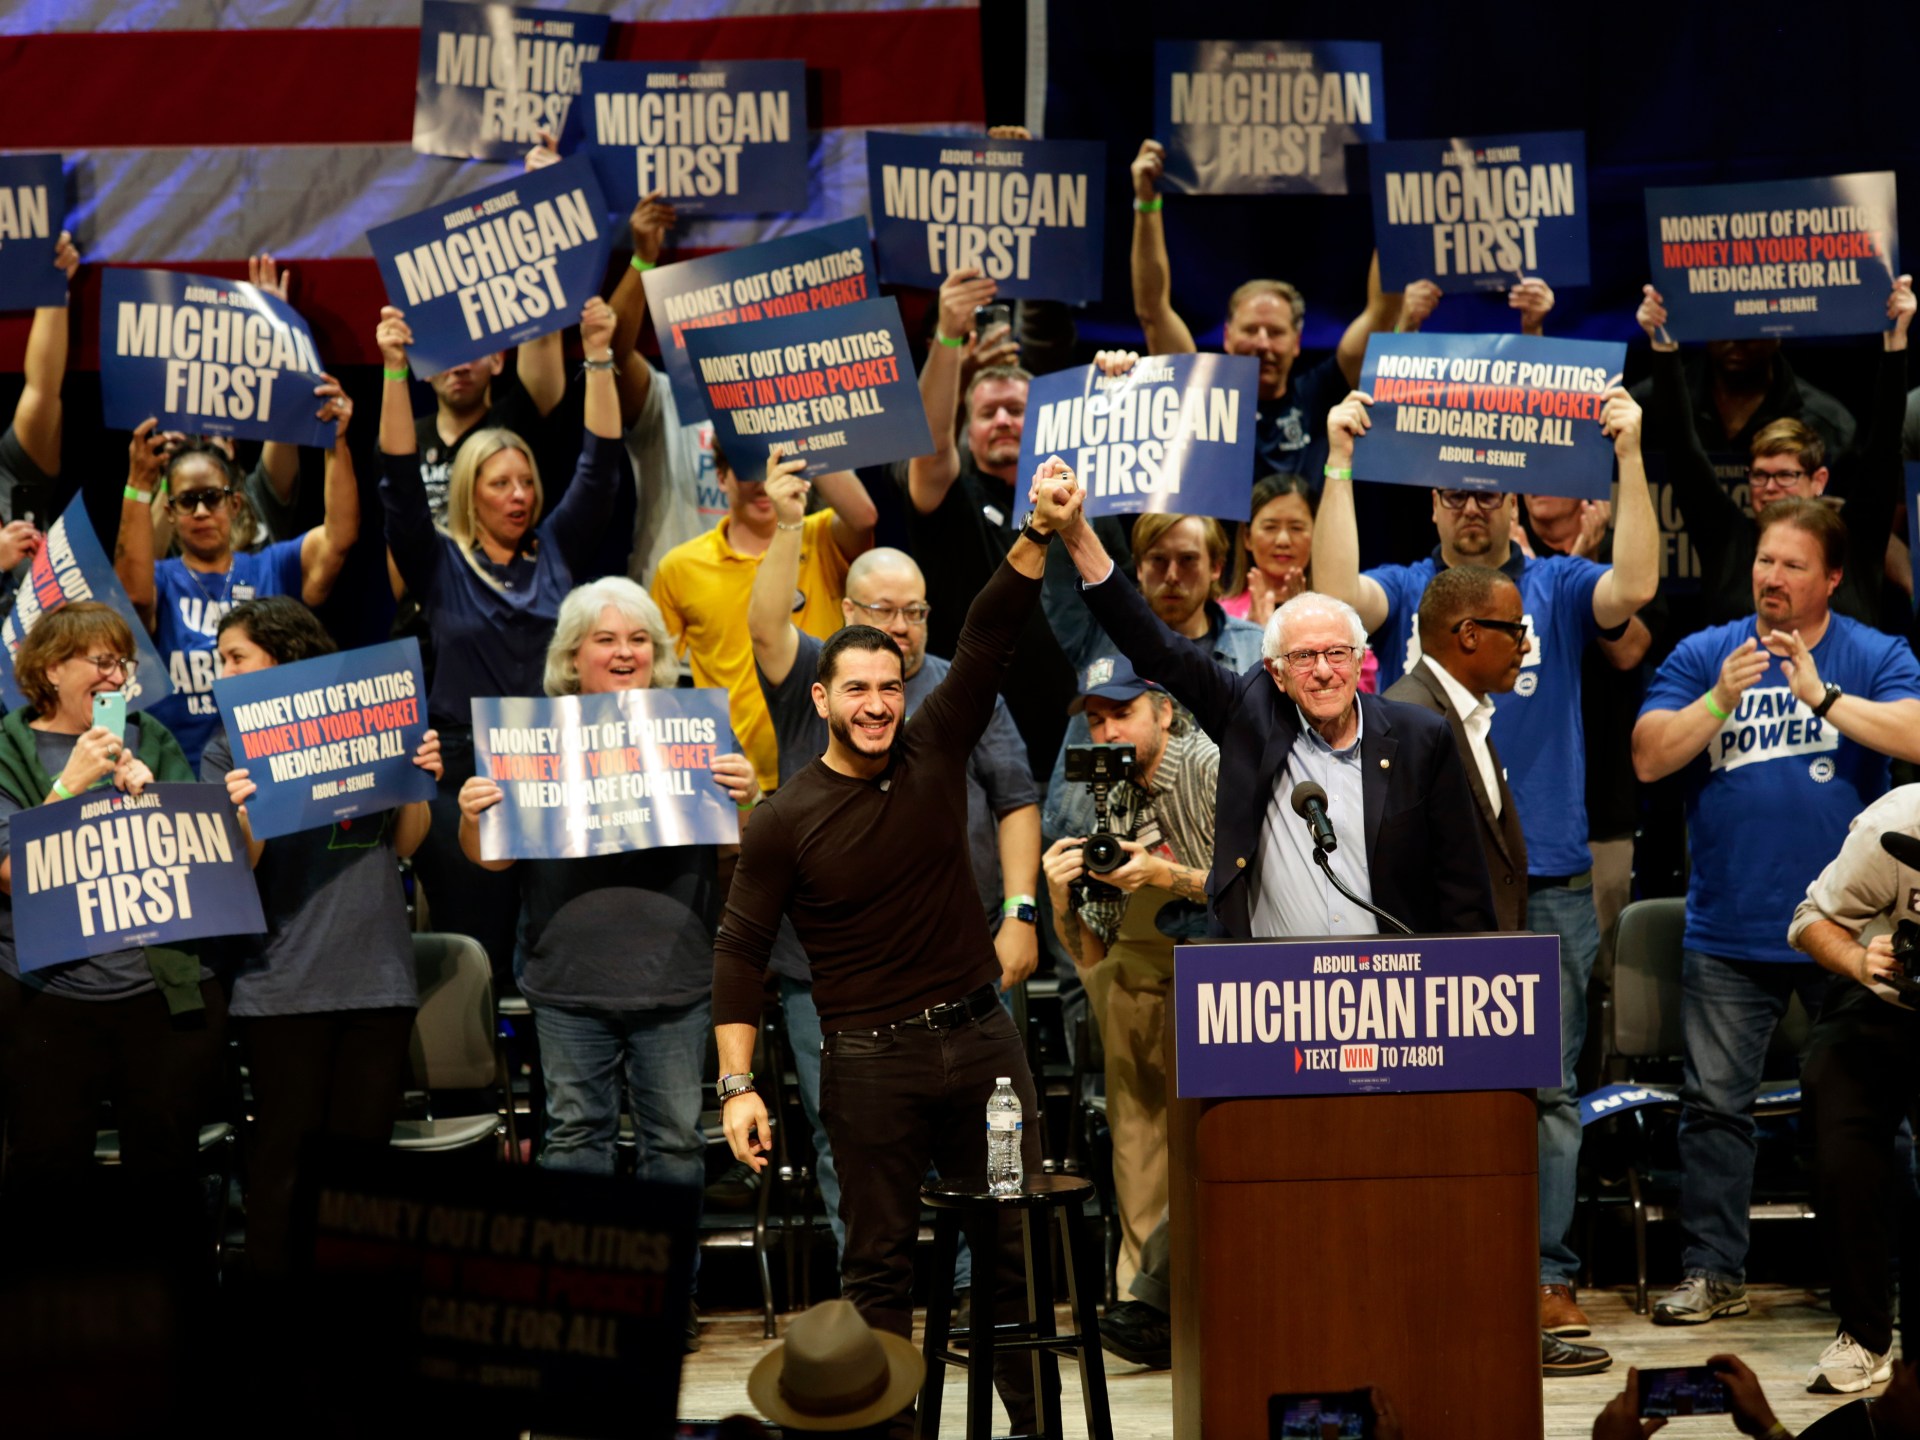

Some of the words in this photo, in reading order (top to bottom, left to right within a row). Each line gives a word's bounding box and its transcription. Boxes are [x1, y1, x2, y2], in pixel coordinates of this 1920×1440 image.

[436, 32, 600, 95] MICHIGA
[594, 91, 790, 145] MICHIGAN
[1170, 72, 1372, 124] MICHIGAN
[636, 144, 743, 197] FIRST
[940, 149, 974, 165] ABDUL
[985, 151, 1024, 167] SENATE
[1218, 124, 1326, 176] FIRST
[443, 206, 476, 231] ABDUL
[882, 165, 1087, 228] MICHIGAN
[1385, 162, 1575, 225] MICHIGAN
[394, 188, 598, 307] MICHIGAN
[927, 222, 1037, 280] FIRST
[1433, 218, 1539, 276] FIRST
[1660, 215, 1728, 242] MONEY
[1730, 211, 1768, 240] OUT
[1770, 210, 1794, 237] OF
[1662, 241, 1730, 269] MONEY
[1732, 240, 1754, 265] IN
[1756, 237, 1808, 264] YOUR
[1688, 263, 1786, 294] MEDICARE
[1788, 262, 1825, 288] FOR
[1828, 260, 1861, 286] ALL
[457, 256, 568, 341] FIRST
[664, 279, 734, 324] MONEY
[733, 271, 771, 305] OUT
[770, 266, 793, 296] OF
[793, 248, 864, 290] POLITICS
[809, 274, 868, 306] POCKET
[1734, 300, 1769, 316] ABDUL
[1779, 296, 1818, 314] SENATE
[116, 301, 322, 375] MICHIGAN
[699, 353, 750, 384] MONEY
[750, 349, 784, 378] OUT
[784, 344, 809, 373] OF
[810, 329, 894, 370] POLITICS
[164, 359, 279, 423] FIRST
[707, 378, 756, 410] MONEY
[756, 376, 777, 406] IN
[774, 370, 828, 402] YOUR
[826, 356, 900, 394] POCKET
[1373, 377, 1445, 406] MONEY
[1446, 382, 1470, 409] IN
[1472, 384, 1525, 414] YOUR
[1527, 388, 1602, 421] POCKET
[1376, 355, 1450, 380] MONEY
[1450, 357, 1490, 383] OUT
[1490, 359, 1517, 386] OF
[1517, 362, 1607, 394] POLITICS
[731, 402, 811, 436] MEDICARE
[810, 395, 850, 424] FOR
[850, 388, 884, 419] ALL
[1034, 386, 1240, 456] MICHIGAN
[1396, 405, 1497, 440] MEDICARE
[1499, 413, 1538, 444] FOR
[1540, 418, 1574, 447] ALL
[807, 430, 848, 451] SENATE
[1439, 445, 1475, 464] ABDUL
[1486, 450, 1527, 469] SENATE
[1077, 440, 1187, 500] FIRST
[187, 695, 217, 715] U.S.
[233, 696, 294, 733] MONEY
[294, 689, 327, 719] OUT
[326, 683, 347, 712] OF
[346, 670, 416, 708] POLITICS
[1734, 692, 1798, 722] UAW
[241, 724, 300, 760] MONEY
[301, 718, 320, 747] IN
[318, 711, 363, 743] YOUR
[362, 698, 419, 734] POCKET
[489, 728, 558, 754] MONEY
[602, 721, 626, 745] OF
[1721, 717, 1823, 760] POWER
[269, 748, 351, 783] MEDICARE
[349, 735, 380, 766] FOR
[381, 729, 405, 760] ALL
[491, 754, 560, 781] MONEY
[588, 748, 641, 777] YOUR
[81, 798, 113, 821] ABDUL
[122, 793, 162, 811] SENATE
[312, 781, 339, 800] ABDUL
[346, 773, 375, 793] SENATE
[612, 808, 651, 827] SENATE
[25, 812, 233, 895] MICHIGAN
[76, 865, 192, 937] FIRST
[1313, 955, 1357, 973] ABDUL
[1359, 962, 1370, 970] US
[1372, 953, 1421, 972] SENATE
[1197, 978, 1416, 1045] MICHIGAN
[1424, 974, 1540, 1038] FIRST
[1304, 1049, 1337, 1070] TEXT
[1344, 1047, 1374, 1069] WIN
[1381, 1047, 1398, 1068] TO
[1400, 1045, 1444, 1067] 74801
